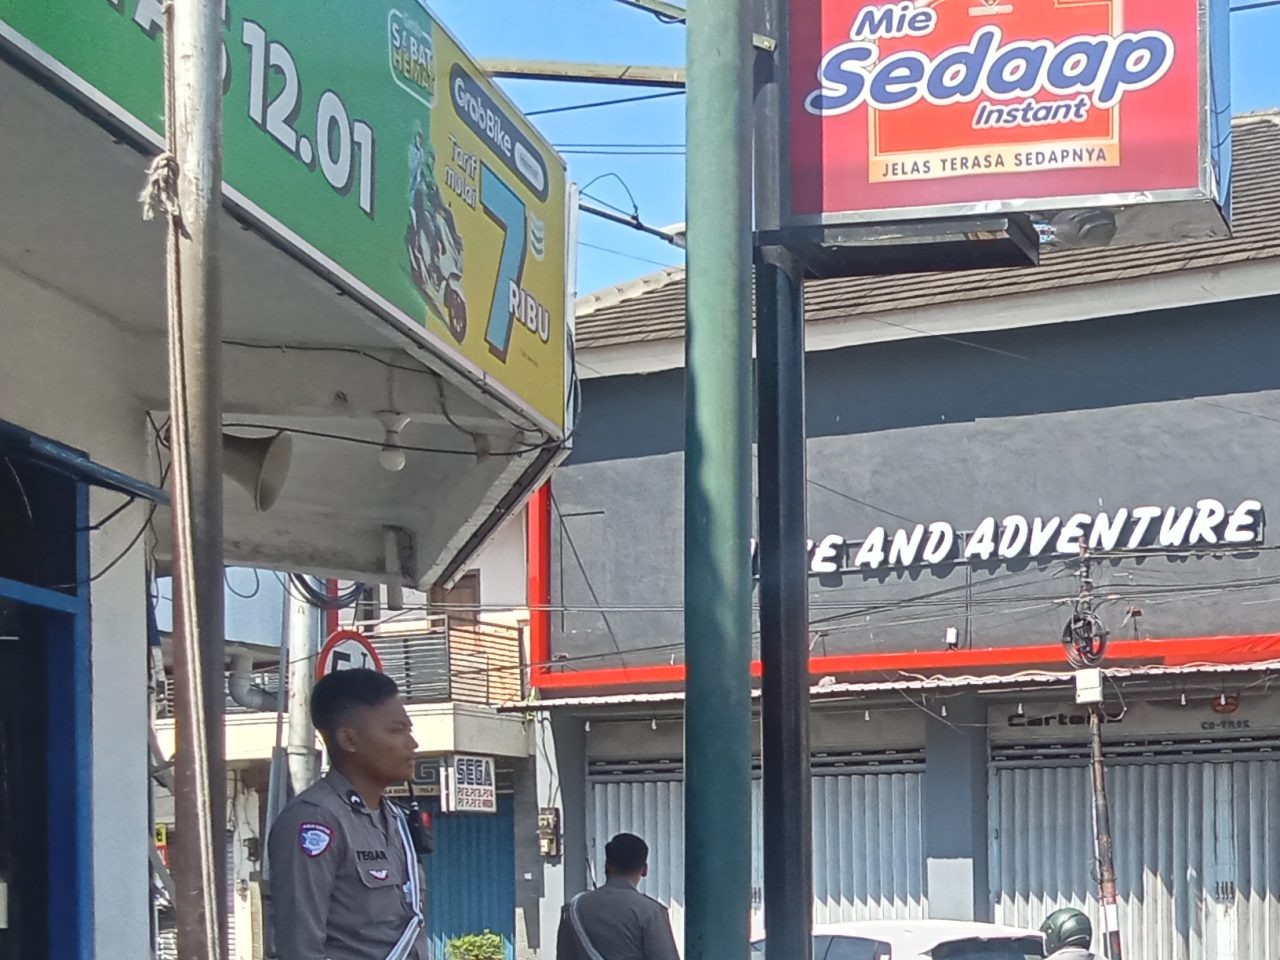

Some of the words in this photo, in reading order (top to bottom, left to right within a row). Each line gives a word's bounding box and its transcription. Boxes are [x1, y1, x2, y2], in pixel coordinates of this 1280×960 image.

[853, 4, 934, 38] Mie
[807, 27, 1171, 113] Sedaap
[242, 20, 373, 214] 12.01
[453, 76, 513, 158] GrabBike
[972, 97, 1088, 127] Instant
[449, 133, 479, 180] Tarif
[881, 162, 931, 178] JELAS
[940, 154, 1005, 173] TERASA
[1013, 147, 1108, 168] SEDAPNYA
[445, 163, 478, 211] mulai
[479, 160, 527, 357] 7
[508, 278, 550, 343] RIBU
[855, 521, 954, 569] AND
[965, 499, 1263, 561] ADVENTURE
[457, 758, 493, 786] SEGA
